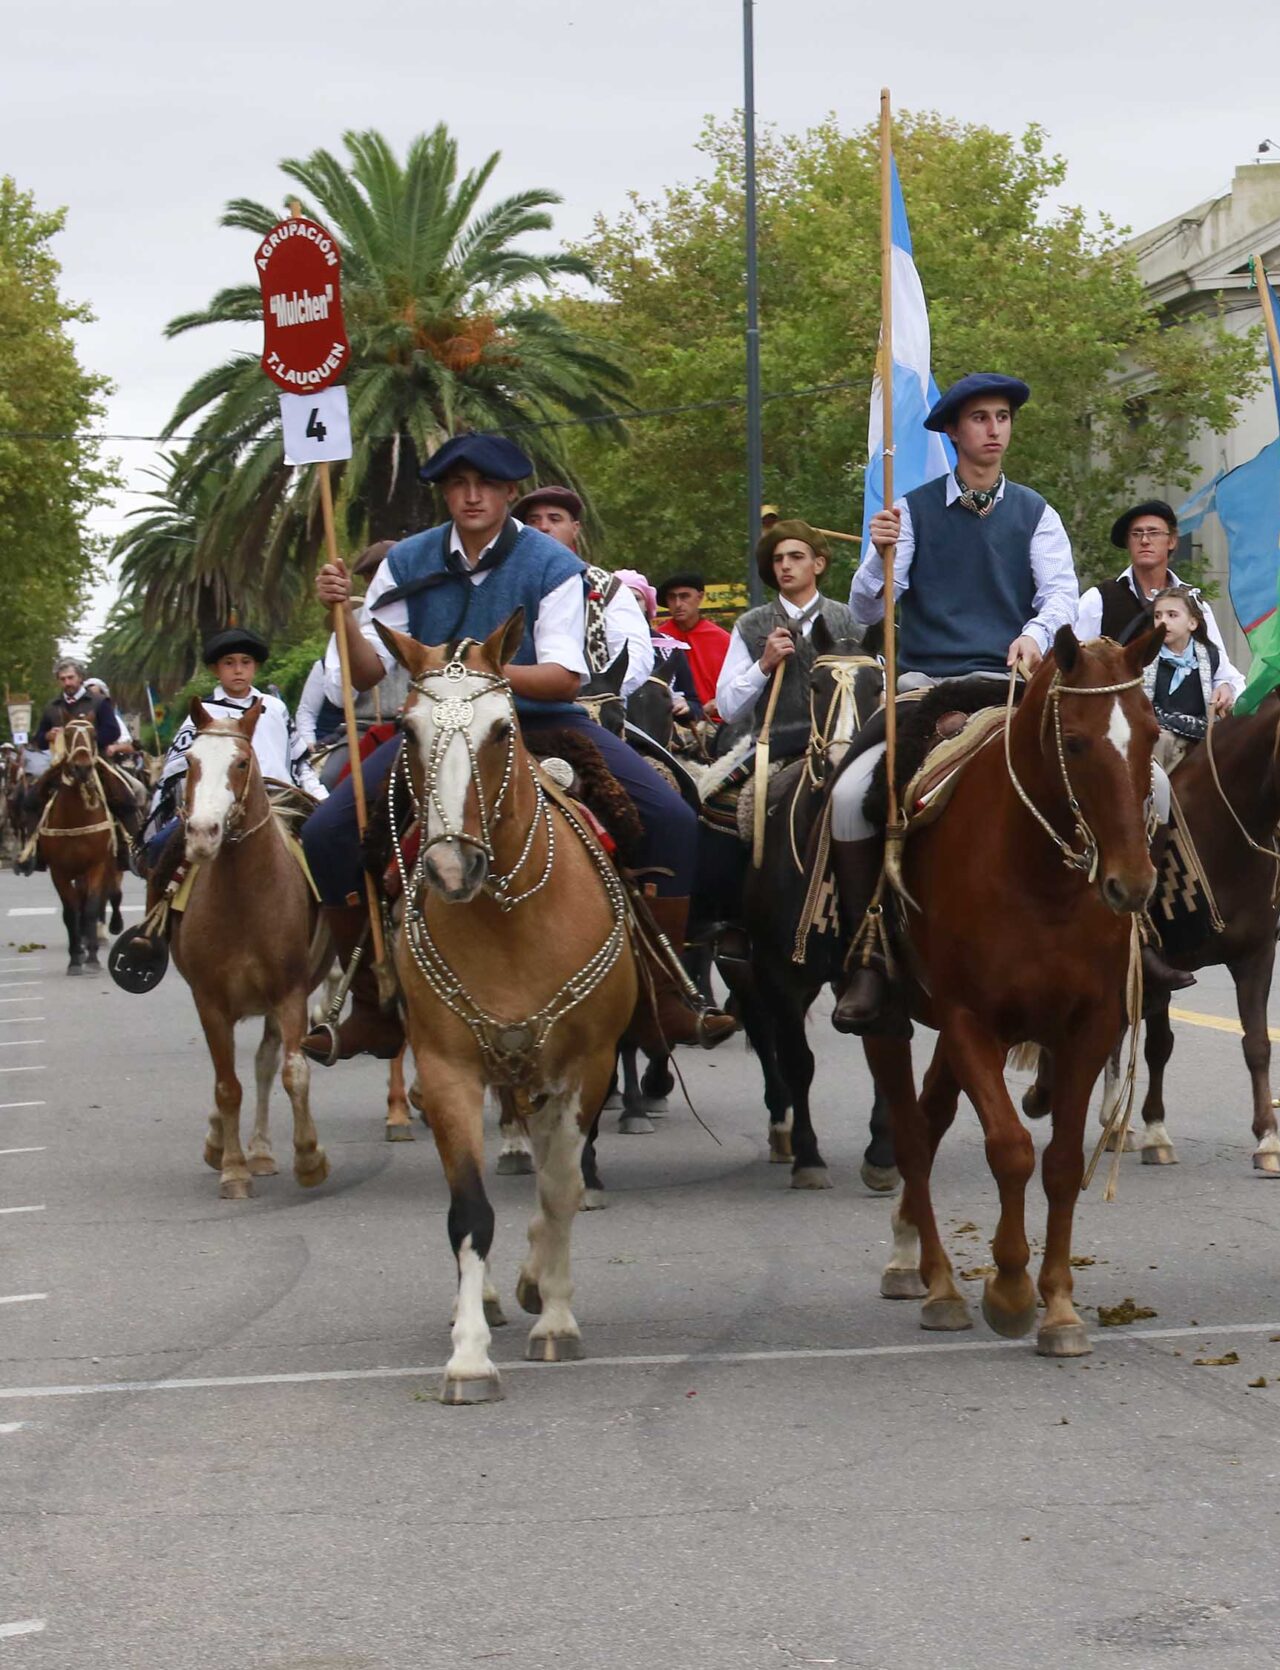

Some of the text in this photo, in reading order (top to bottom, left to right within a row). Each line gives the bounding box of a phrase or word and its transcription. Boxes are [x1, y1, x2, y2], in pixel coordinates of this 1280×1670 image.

[256, 222, 338, 272] AGRUPACIÓN
[270, 284, 333, 328] "Mulchen"
[306, 408, 327, 442] 4
